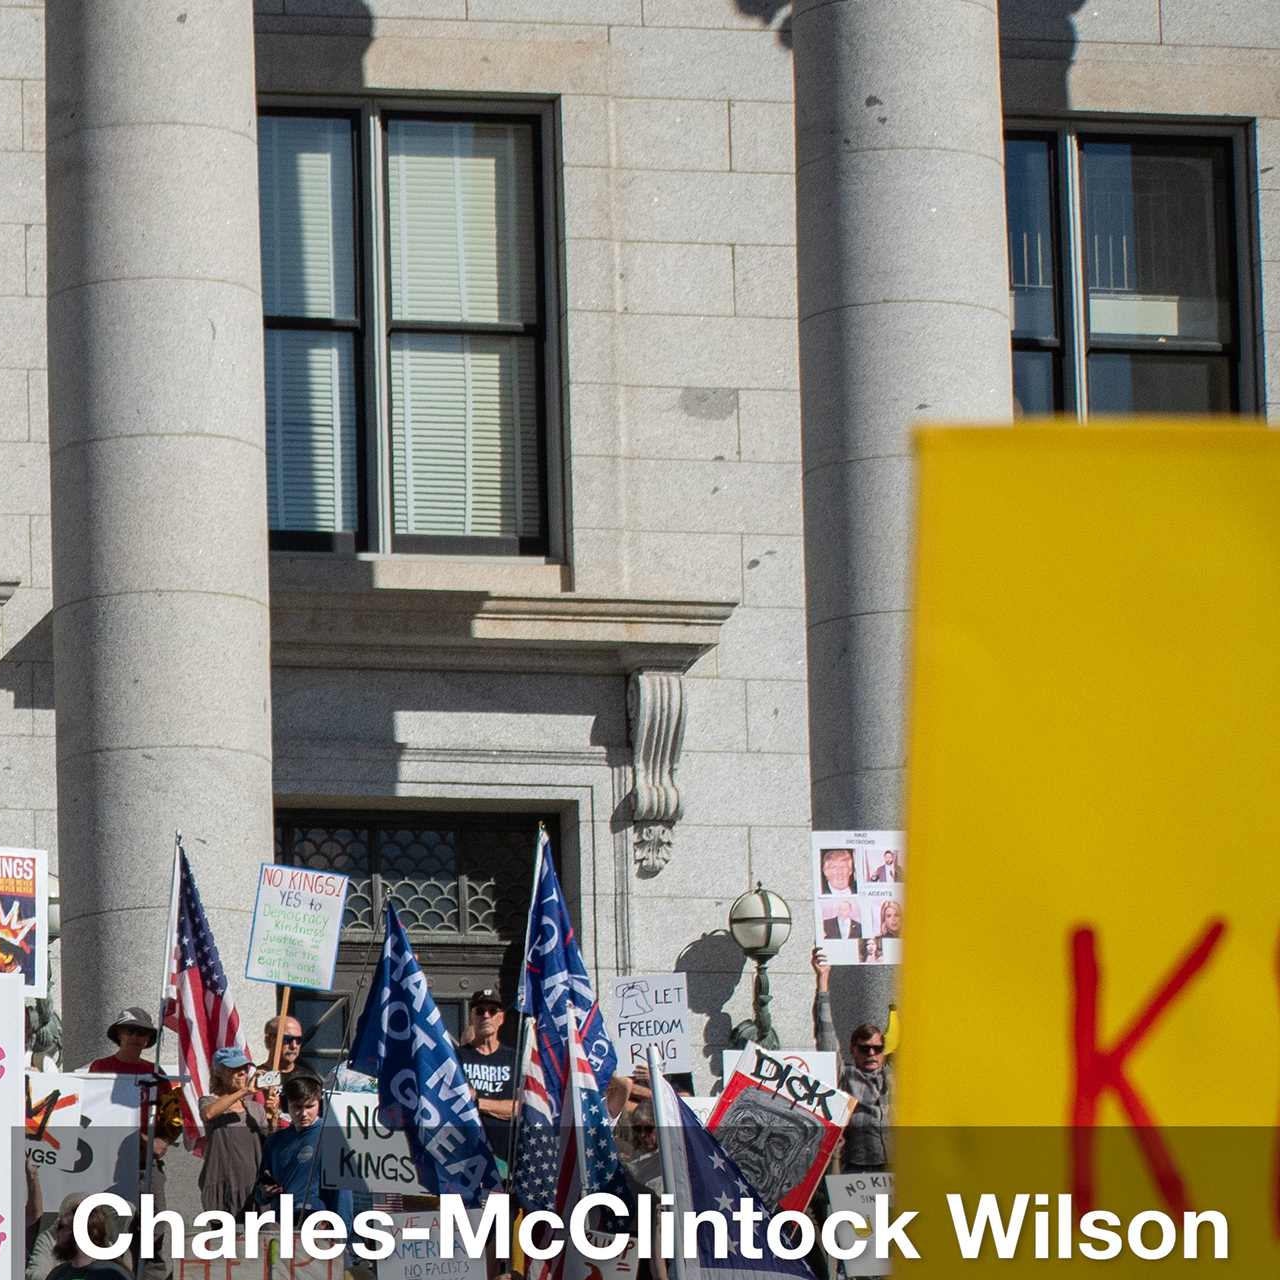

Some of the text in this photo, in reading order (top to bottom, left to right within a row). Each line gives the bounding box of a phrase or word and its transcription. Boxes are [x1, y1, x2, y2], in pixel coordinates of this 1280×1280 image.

[262, 868, 346, 897] NO KINGS!
[280, 890, 300, 908] YES
[263, 904, 329, 929] Democracy
[275, 921, 324, 938] Kindness
[263, 930, 303, 947] Justice
[258, 956, 289, 969] earth
[288, 972, 321, 986] beings
[655, 987, 683, 1004] LET
[618, 1019, 684, 1038] FREEDOM
[463, 1063, 511, 1081] HARRIS
[341, 1148, 415, 1179] KINGS
[425, 1260, 469, 1274] FACISTS
